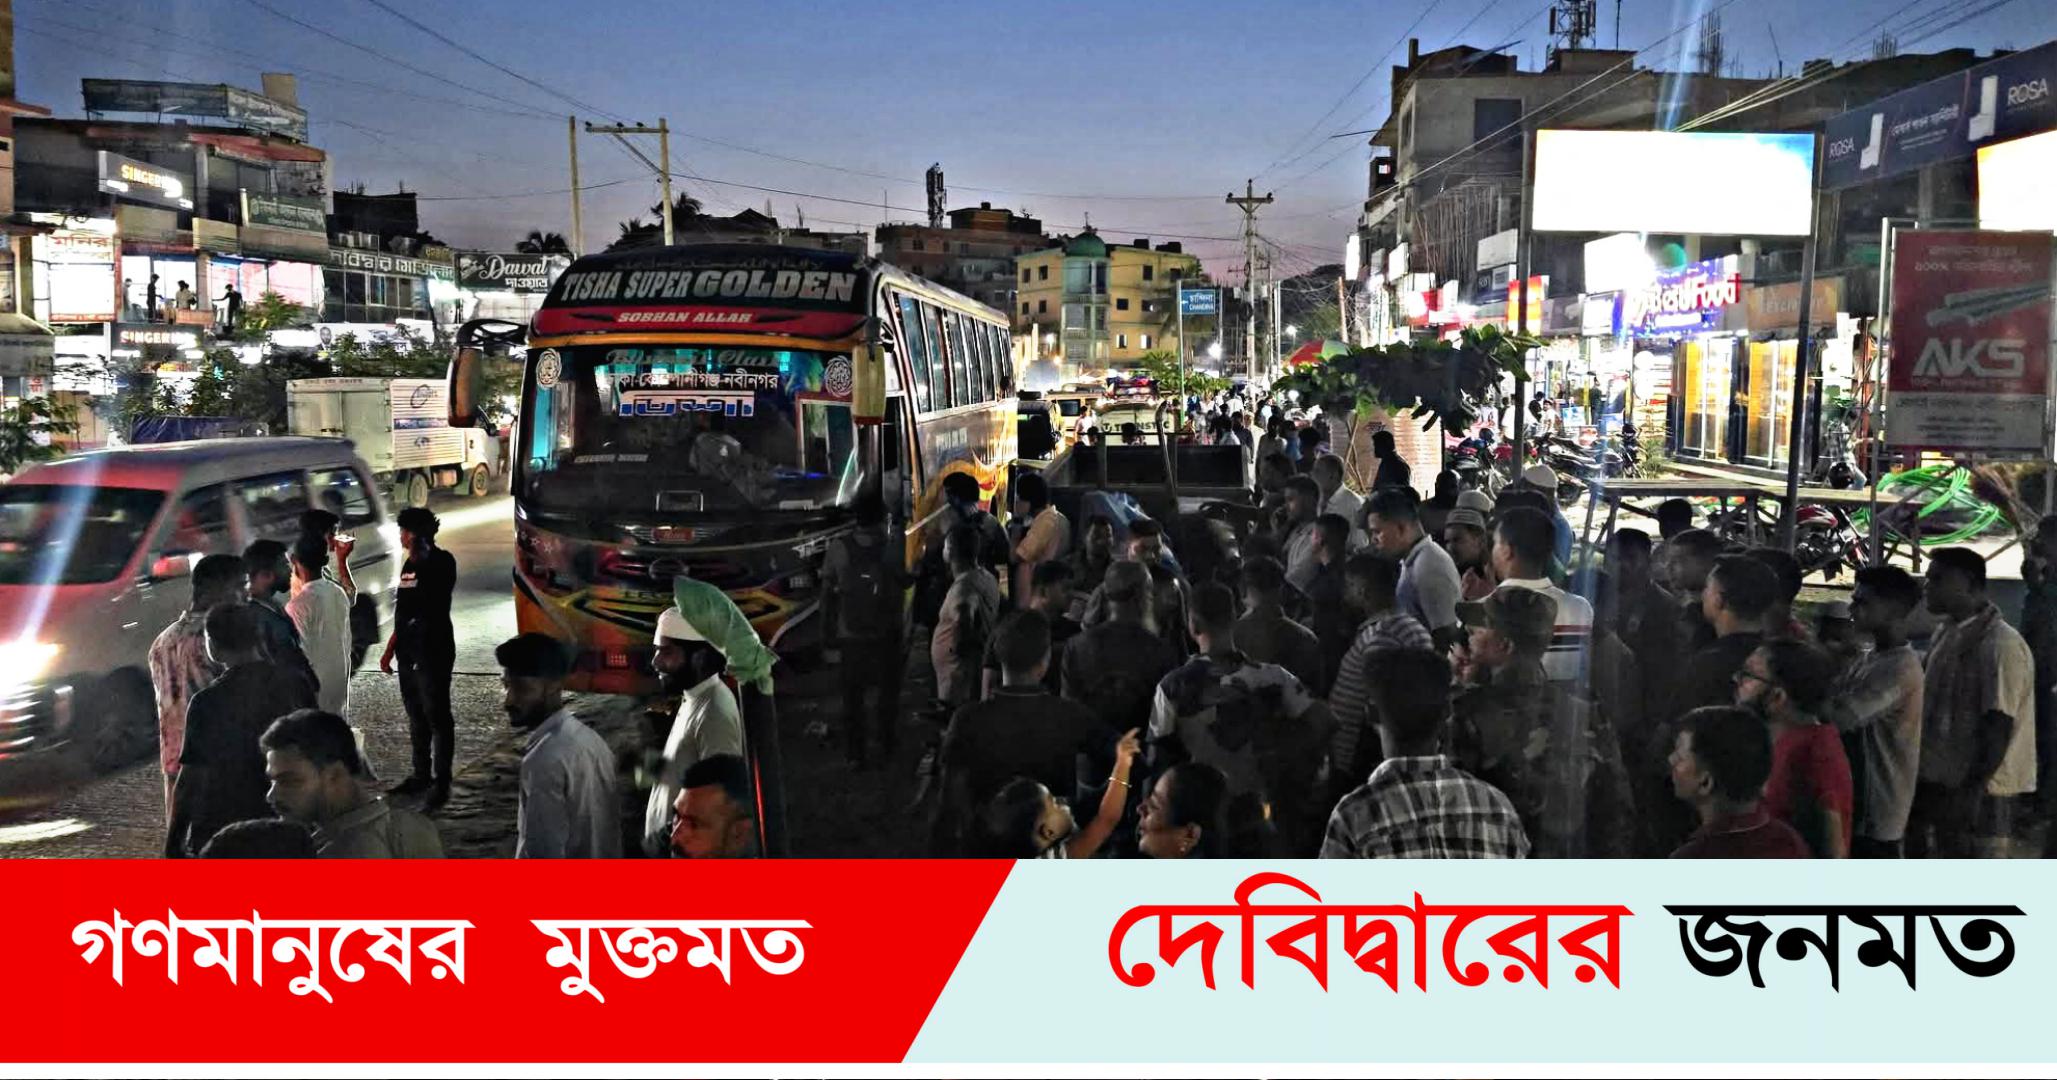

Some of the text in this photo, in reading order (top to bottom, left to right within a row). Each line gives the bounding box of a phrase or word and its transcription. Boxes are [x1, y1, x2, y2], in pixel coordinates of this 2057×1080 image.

[2008, 78, 2048, 106] ROSA
[1830, 137, 1855, 158] ROSA
[479, 255, 552, 280] Dawat
[561, 270, 856, 301] TISHA SUPER GOLDEN
[618, 312, 752, 323] SOBHAN ALLAH
[120, 331, 170, 344] SINGER
[1912, 337, 2026, 377] AKS
